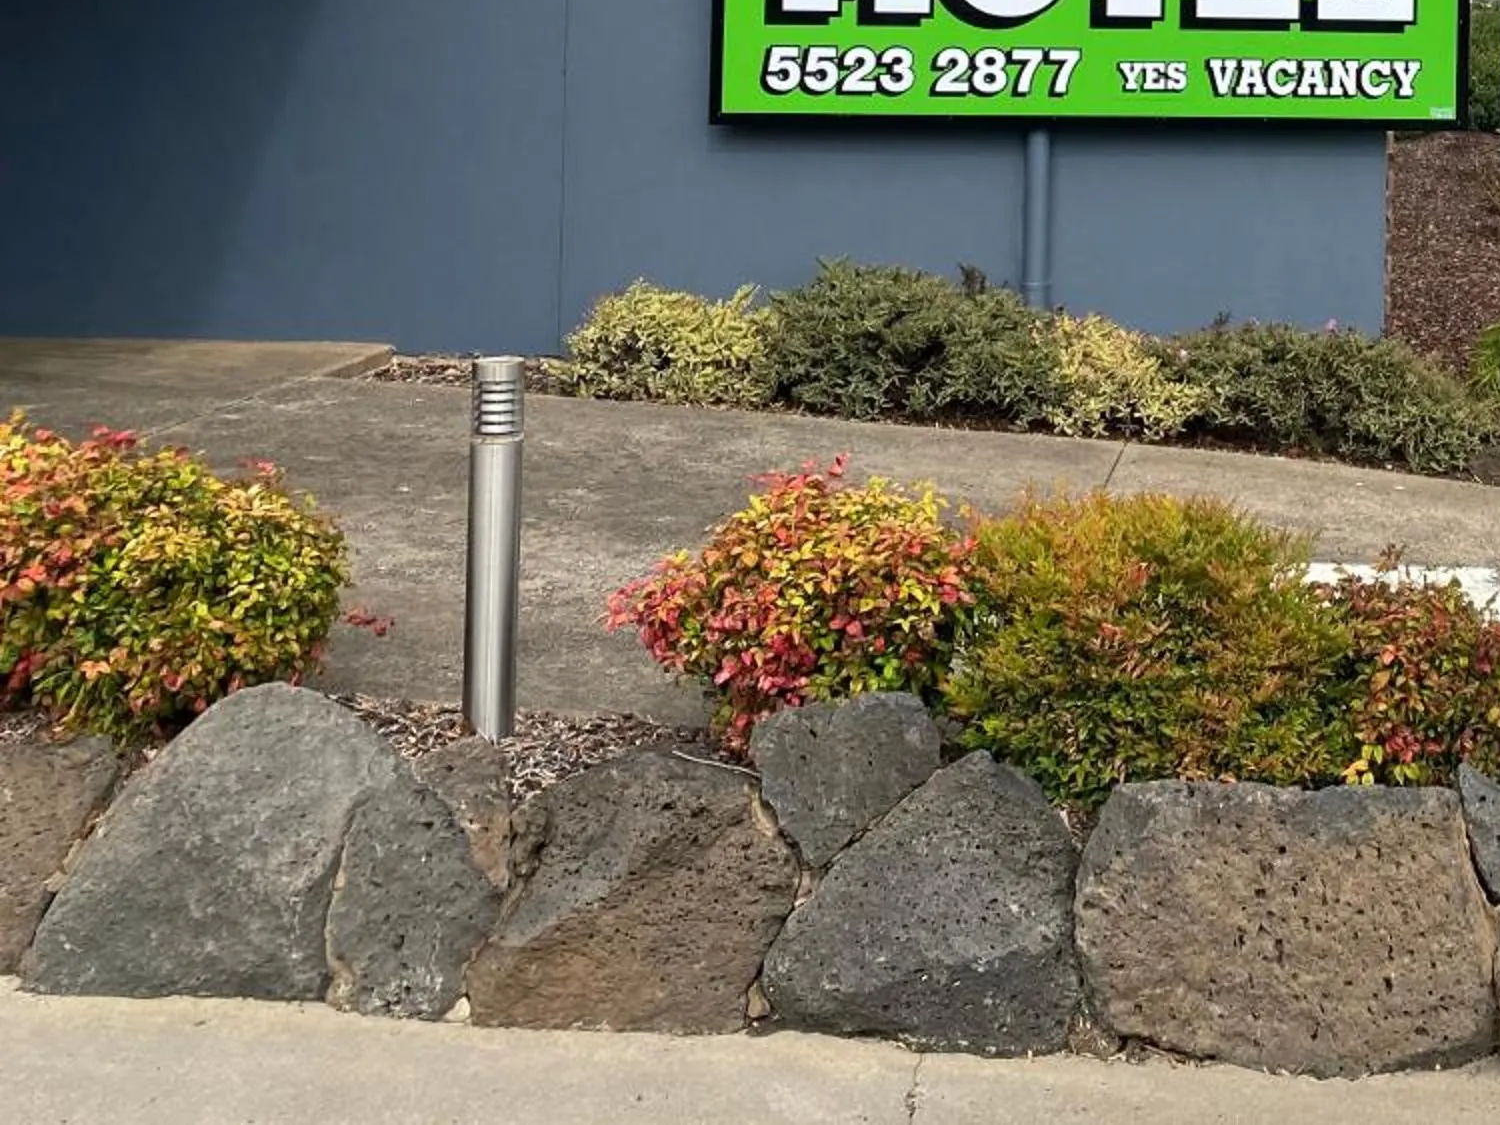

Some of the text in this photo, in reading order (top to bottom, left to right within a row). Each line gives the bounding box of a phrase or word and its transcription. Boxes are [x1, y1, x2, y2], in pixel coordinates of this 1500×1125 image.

[761, 45, 1421, 99] 5523 2877 YES VACANCY
